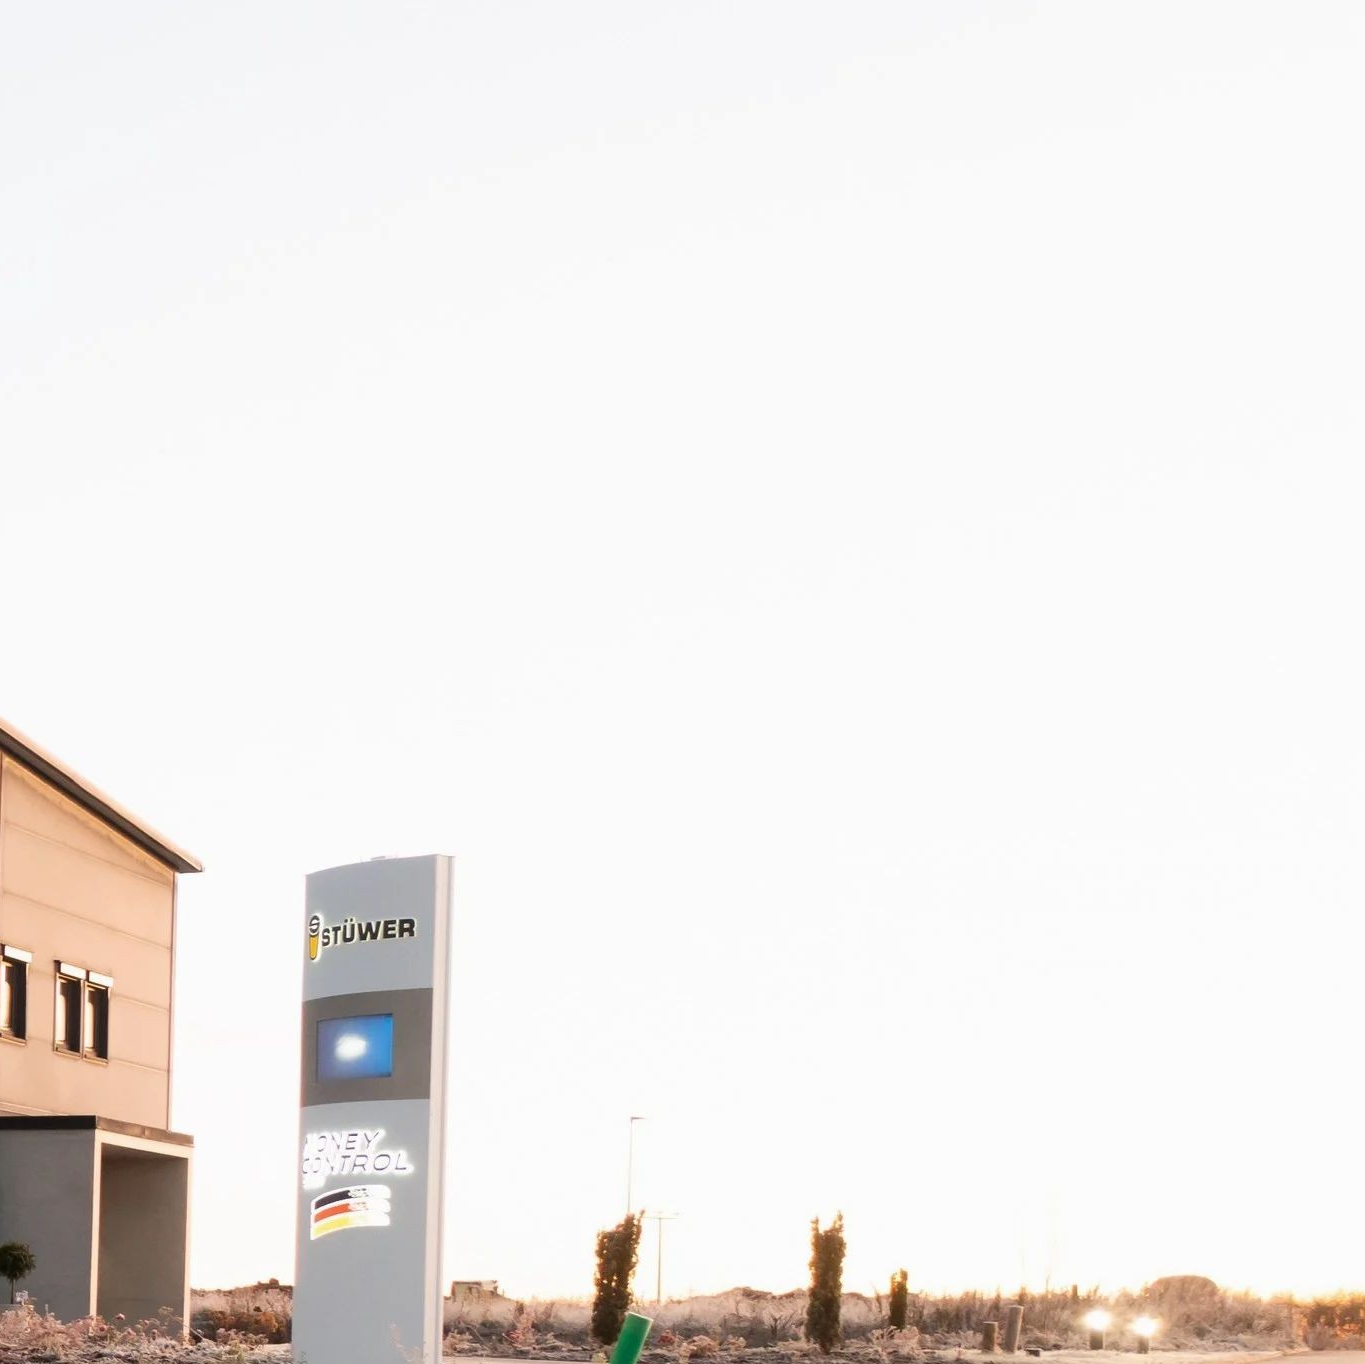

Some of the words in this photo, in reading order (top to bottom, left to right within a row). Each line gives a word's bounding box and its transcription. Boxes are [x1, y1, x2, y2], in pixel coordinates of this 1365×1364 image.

[322, 918, 415, 946] STÜWER
[304, 1130, 380, 1153] ONEY
[302, 1150, 407, 1174] CONTROL
